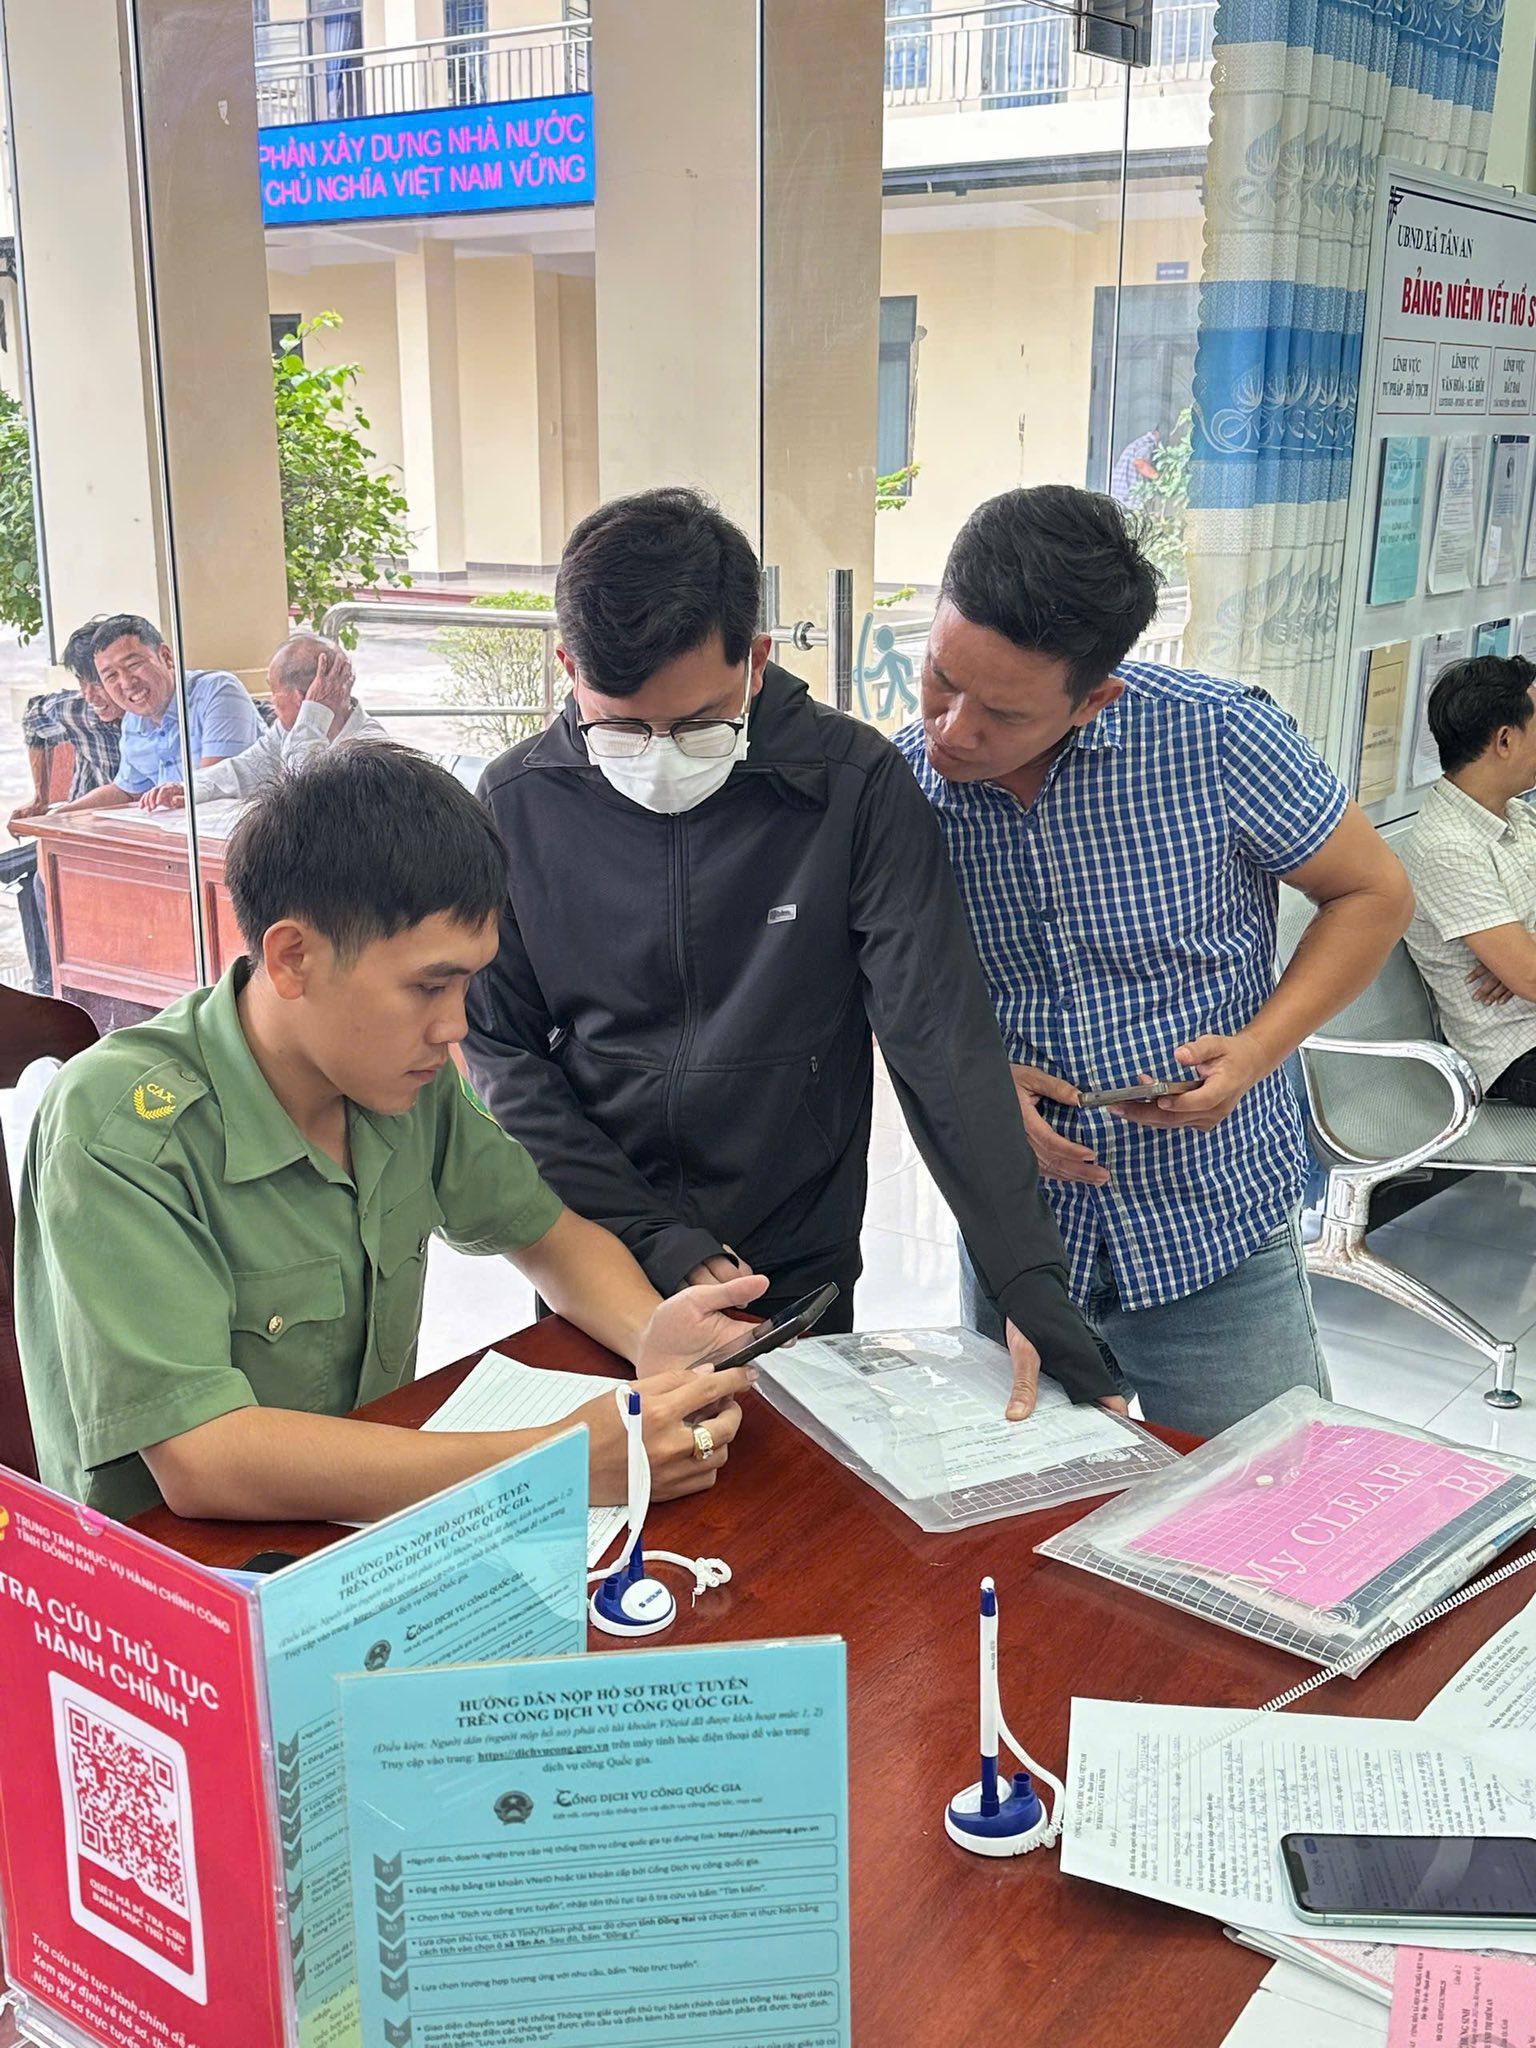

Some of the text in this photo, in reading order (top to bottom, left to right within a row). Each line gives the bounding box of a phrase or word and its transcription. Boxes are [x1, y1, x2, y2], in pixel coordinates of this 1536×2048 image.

[321, 131, 365, 166] XÂY
[371, 128, 442, 164] DỰNG
[448, 115, 499, 153] NHÀ
[506, 108, 585, 149] NƯỚC
[265, 151, 586, 206] CHỦ NGHĨA VIỆT NAM VỮNG
[1397, 224, 1474, 259] UBND XÃ TÂN AN
[1401, 266, 1443, 318] BẢNG
[1445, 277, 1484, 321] NIÊM
[1487, 279, 1509, 325] YẾT
[1528, 295, 1536, 328] S
[146, 1083, 176, 1103] CAX
[15, 1527, 96, 1577] TỈNH ĐỒNG NAI
[1225, 1548, 1307, 1595] My
[1290, 1462, 1424, 1546] CLEAR
[14, 1512, 231, 1634] TRUNG TÂM PHỤC VỤ HÀNH CHÍNH CÔNG
[0, 1571, 219, 1710] TRA CỨU THỦ TỤC
[34, 1621, 189, 1727] HÀNH CHÍNH
[460, 1676, 750, 1712] HƯỚNG DẪN NỘP HỒ SƠ TRỰC TUYẾN
[456, 1712, 499, 1728] TRÊN
[554, 1706, 593, 1722] DỊCH
[597, 1704, 619, 1717] VỤ
[622, 1699, 668, 1714] CÔNG
[672, 1695, 719, 1712] QUỐC
[721, 1694, 754, 1707] GIA.
[32, 1933, 50, 1953] Tra
[51, 1948, 70, 1968] cứu
[71, 1960, 89, 1982] thủ
[90, 1975, 109, 1995] tục
[110, 1987, 138, 2014] hành
[139, 2010, 169, 2037] chính
[32, 1953, 56, 1976] Xem
[56, 1971, 77, 1992] quy
[78, 1985, 102, 2009] định
[103, 2001, 117, 2018] về
[118, 2012, 133, 2030] hồ
[33, 1971, 140, 2048] Nộp hồ sơ trực tuyến
